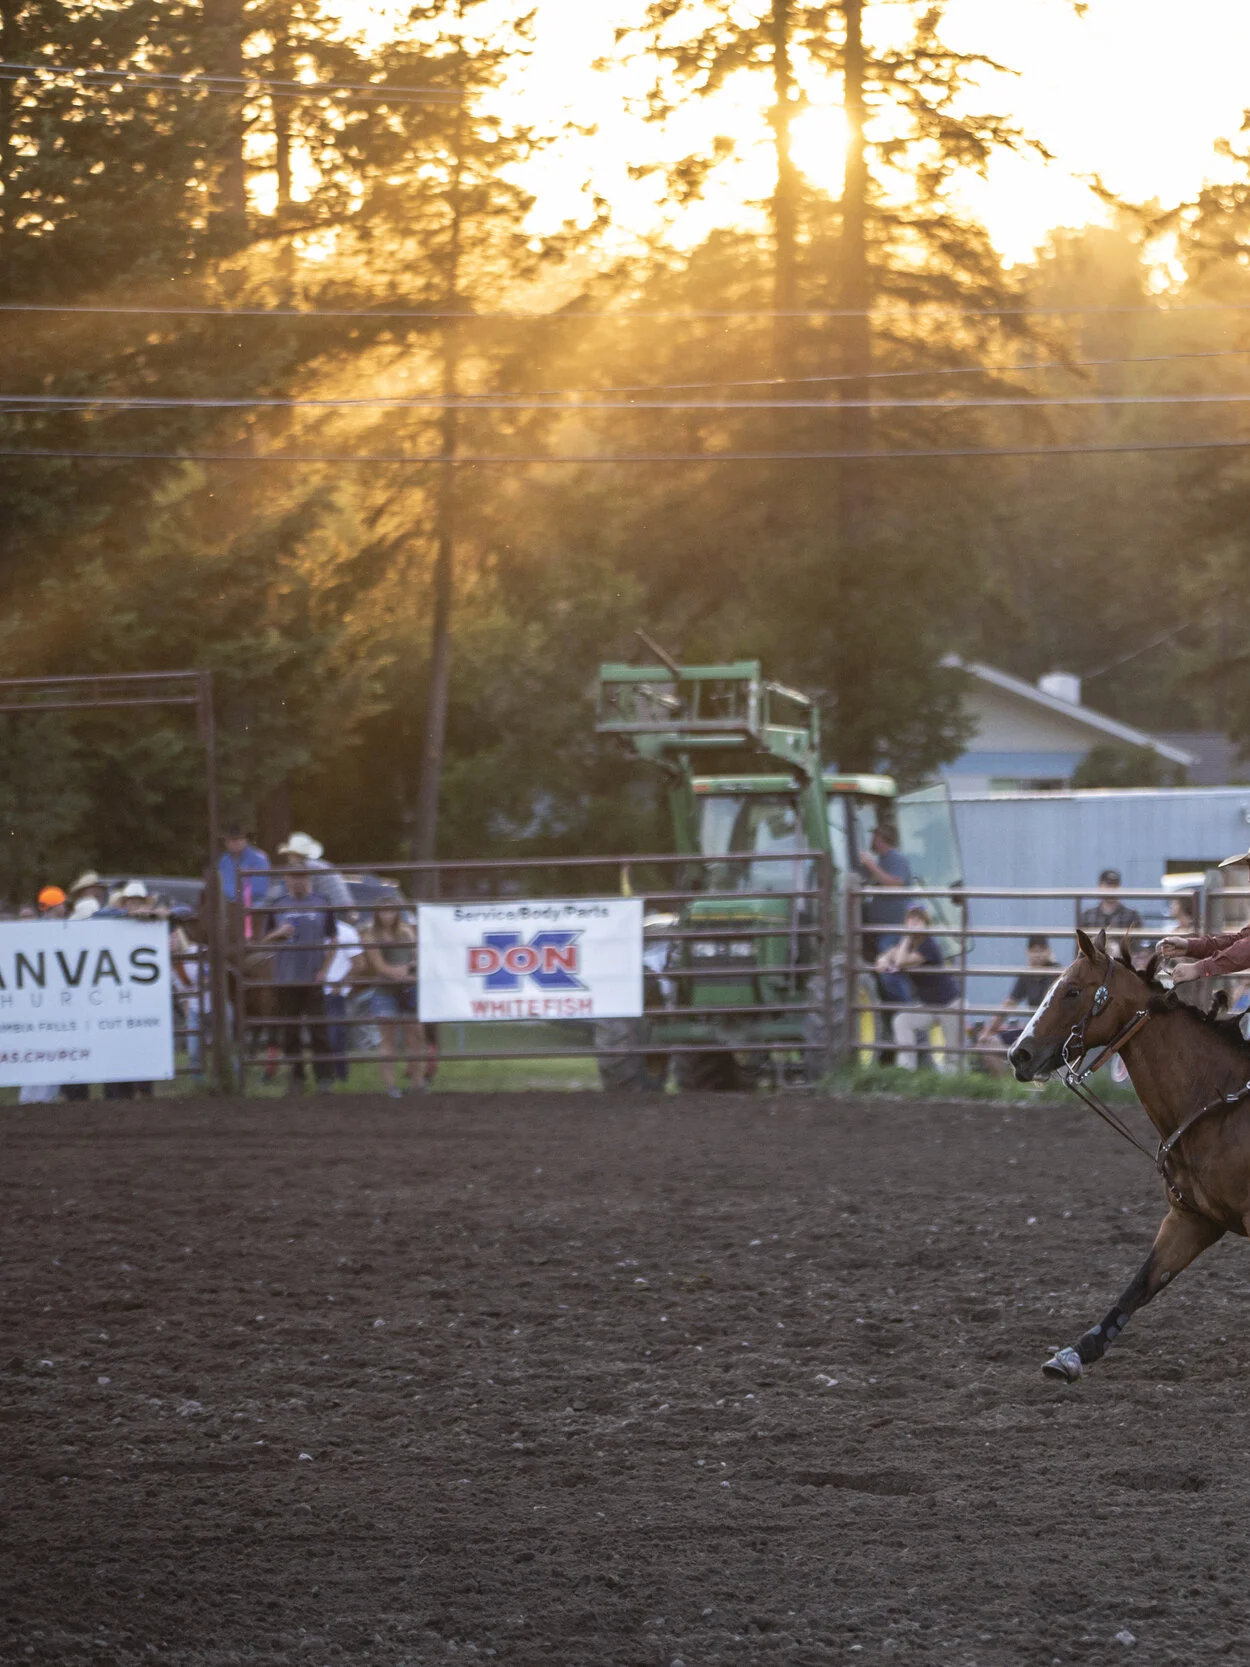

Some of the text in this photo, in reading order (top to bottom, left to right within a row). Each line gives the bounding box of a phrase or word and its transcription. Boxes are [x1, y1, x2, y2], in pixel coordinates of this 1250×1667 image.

[0, 948, 160, 990] NVAS
[467, 944, 579, 977] DON
[470, 998, 593, 1018] WHITEFISH
